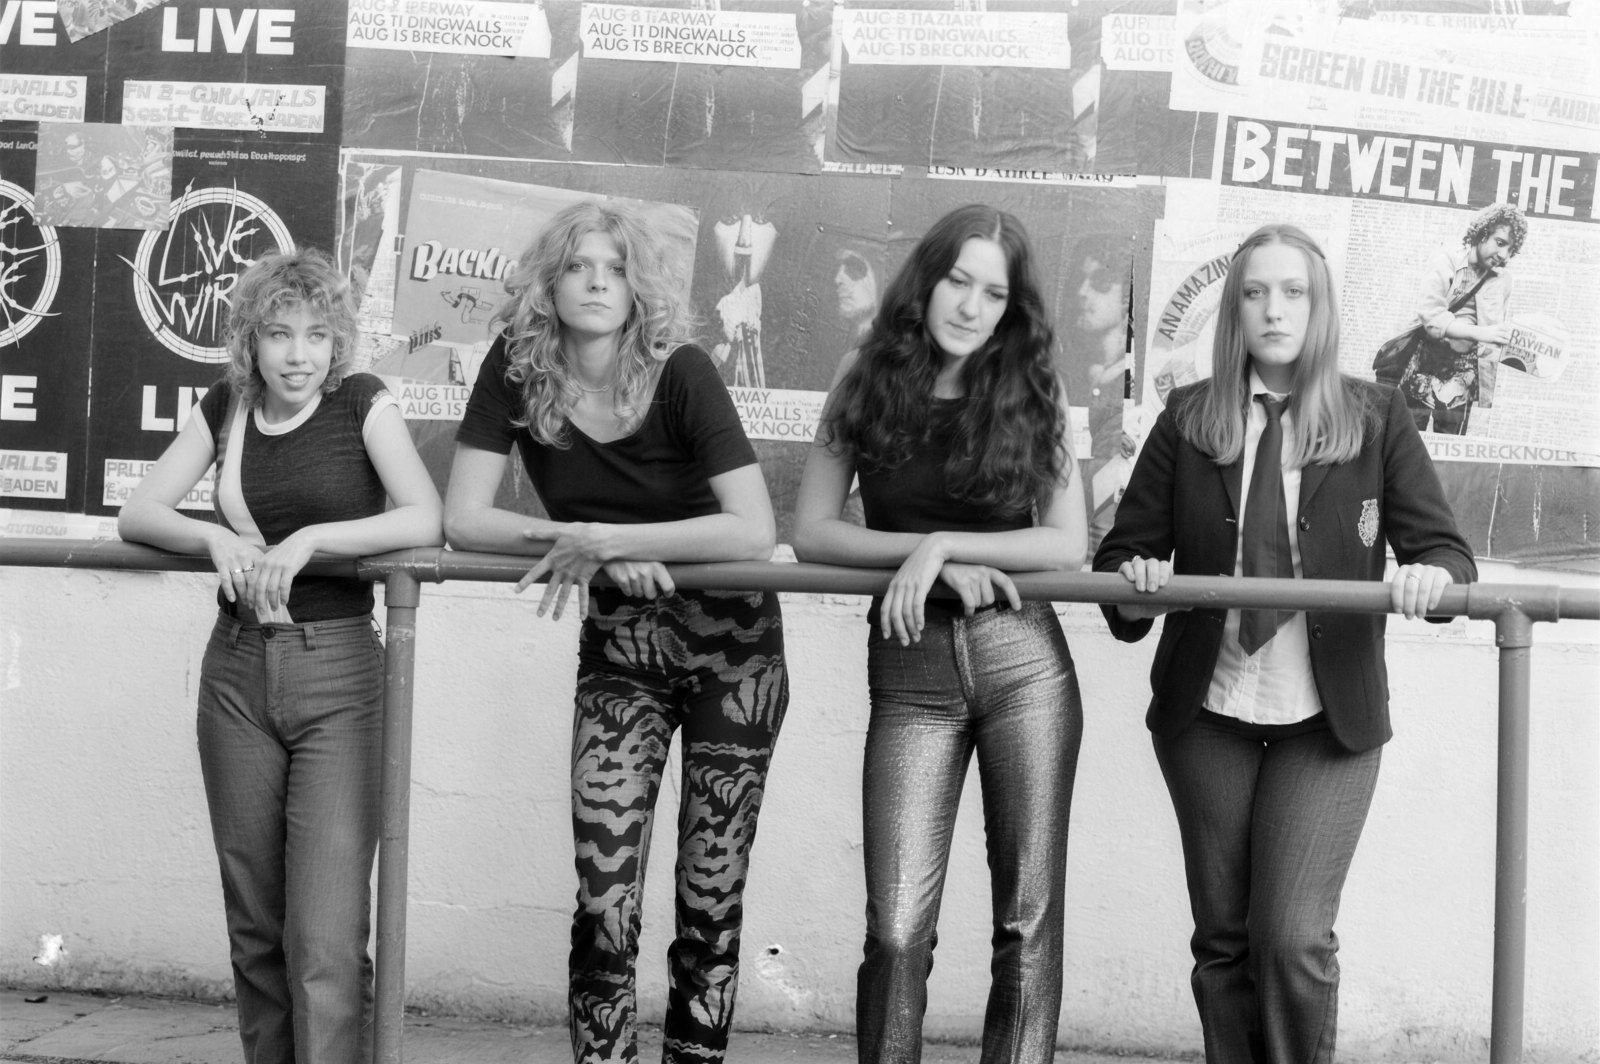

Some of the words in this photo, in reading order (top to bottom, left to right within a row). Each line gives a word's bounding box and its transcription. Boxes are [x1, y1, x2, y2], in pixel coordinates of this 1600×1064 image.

[161, 7, 295, 55] LIVE
[349, 12, 386, 27] AUG
[408, 16, 502, 34] DINGWALLS
[353, 27, 389, 41] AUG
[412, 30, 513, 48] BRECKNOCK
[649, 26, 747, 43] DINGWALLS
[592, 37, 630, 52] AUG
[653, 40, 758, 59] BRECKNOCK
[920, 43, 1030, 59] BRECKNOCK
[1259, 42, 1366, 92] SCREEN
[1370, 59, 1410, 99] ON
[1415, 67, 1464, 108] THE
[1467, 75, 1526, 119] HILL
[1232, 121, 1475, 205] BETWEEN
[1492, 149, 1579, 217] THE
[1171, 256, 1231, 315] AMAZIN
[401, 387, 438, 400] AUG
[405, 401, 442, 416] AUG
